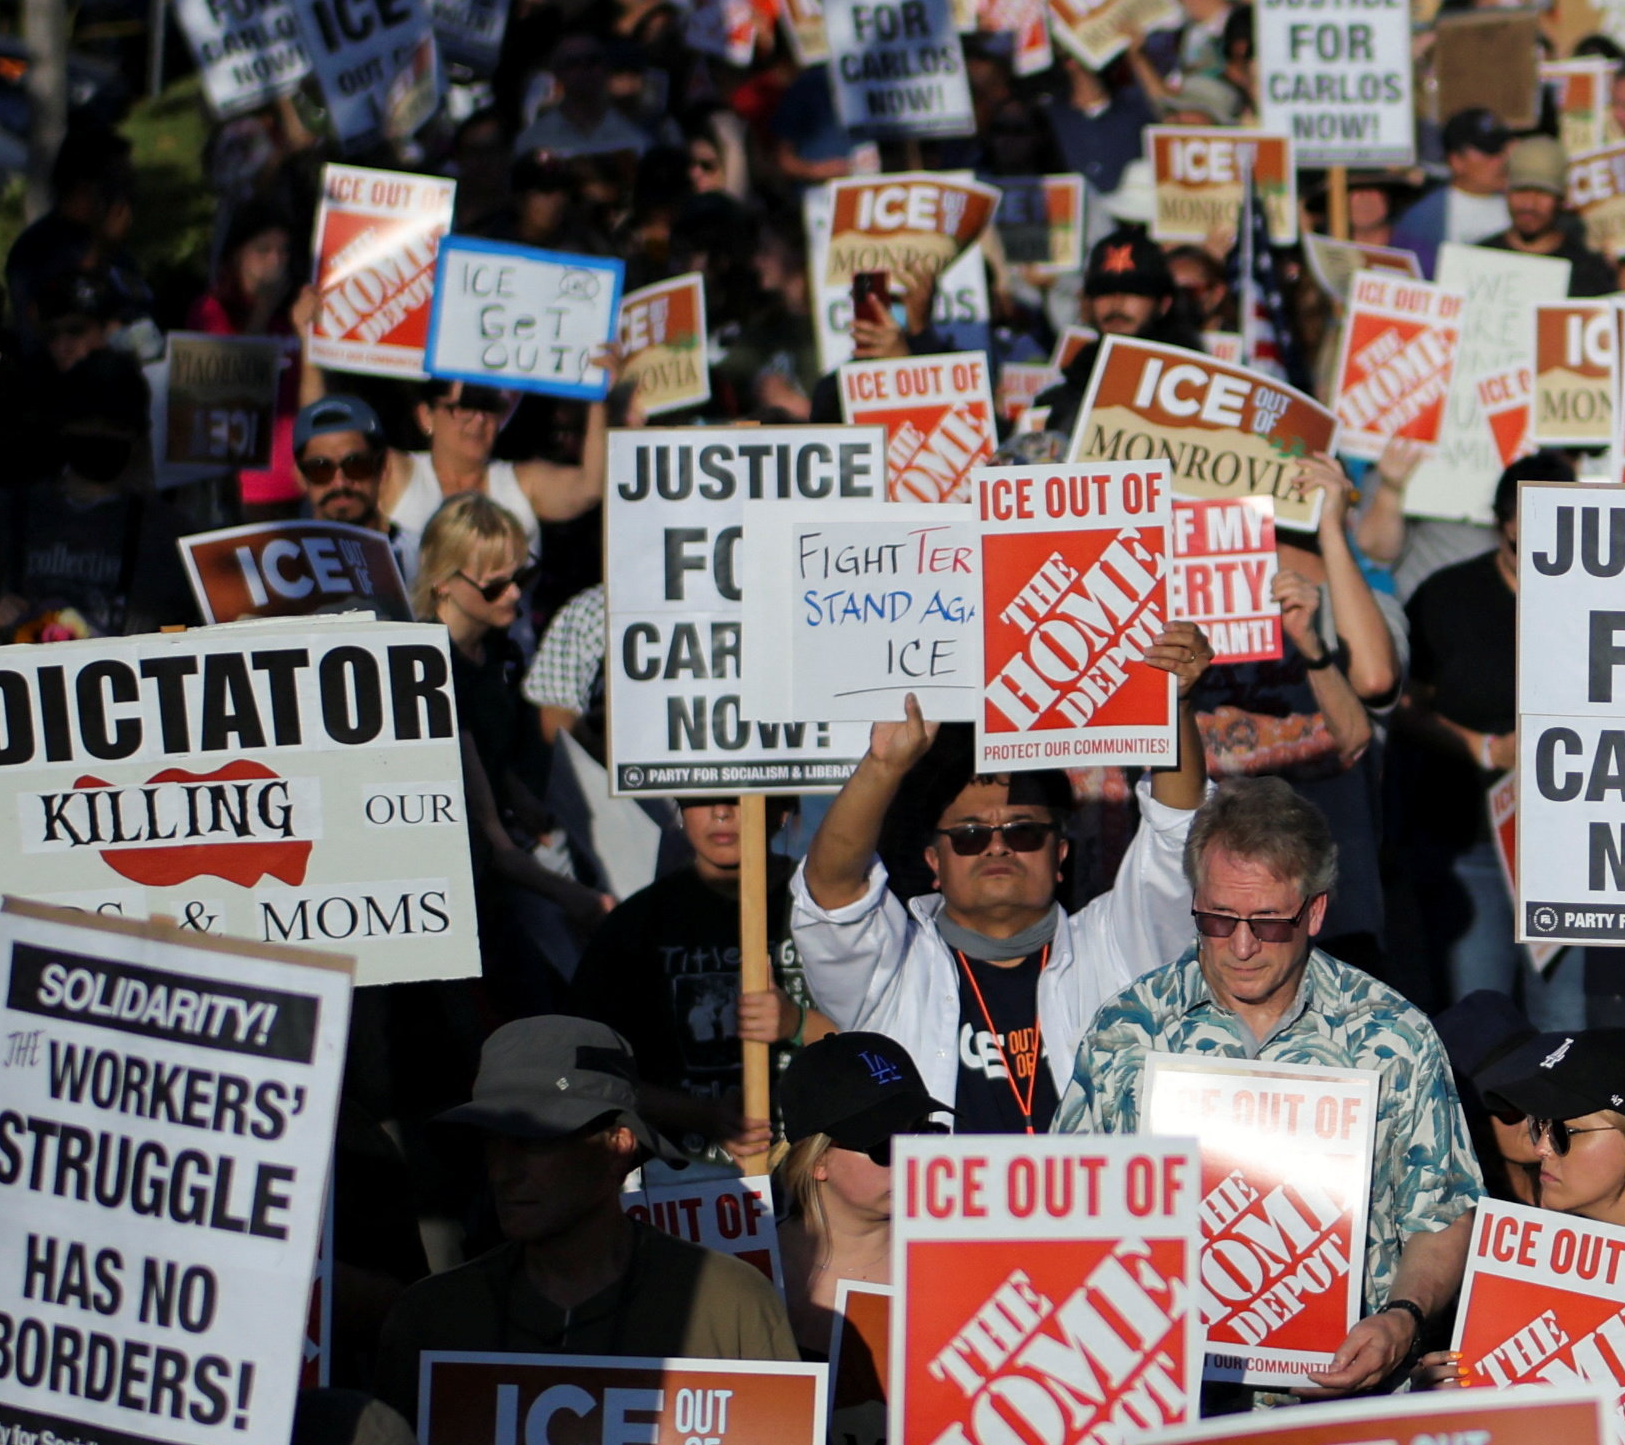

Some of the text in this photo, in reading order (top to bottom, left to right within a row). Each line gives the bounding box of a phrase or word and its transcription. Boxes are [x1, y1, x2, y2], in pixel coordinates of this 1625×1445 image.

[1288, 23, 1373, 62] FOR
[1267, 73, 1404, 105] CARLOS
[1293, 112, 1381, 142] NOW!
[857, 190, 941, 230] ICE
[462, 263, 516, 297] ICE
[1134, 357, 1289, 429] ICE OUT
[1251, 407, 1279, 435] OF
[1086, 423, 1309, 506] MONROVIA
[980, 472, 1162, 521] ICE OUT OF
[799, 532, 898, 579] FIGHT
[803, 591, 914, 624] STAND
[887, 639, 957, 677] ICE
[984, 739, 1169, 761] PROTECT OUR COMMUNITIES!
[42, 785, 295, 846] KILLING
[366, 794, 455, 827] OUR
[261, 892, 450, 942] MOMS
[1565, 913, 1613, 930] PARTY
[40, 965, 277, 1043] SOLIDARITY!
[2, 1031, 44, 1067] THE
[907, 1155, 1186, 1218] ICE OUT OF
[23, 1234, 217, 1334] HAS NO
[929, 1270, 1052, 1397] THE
